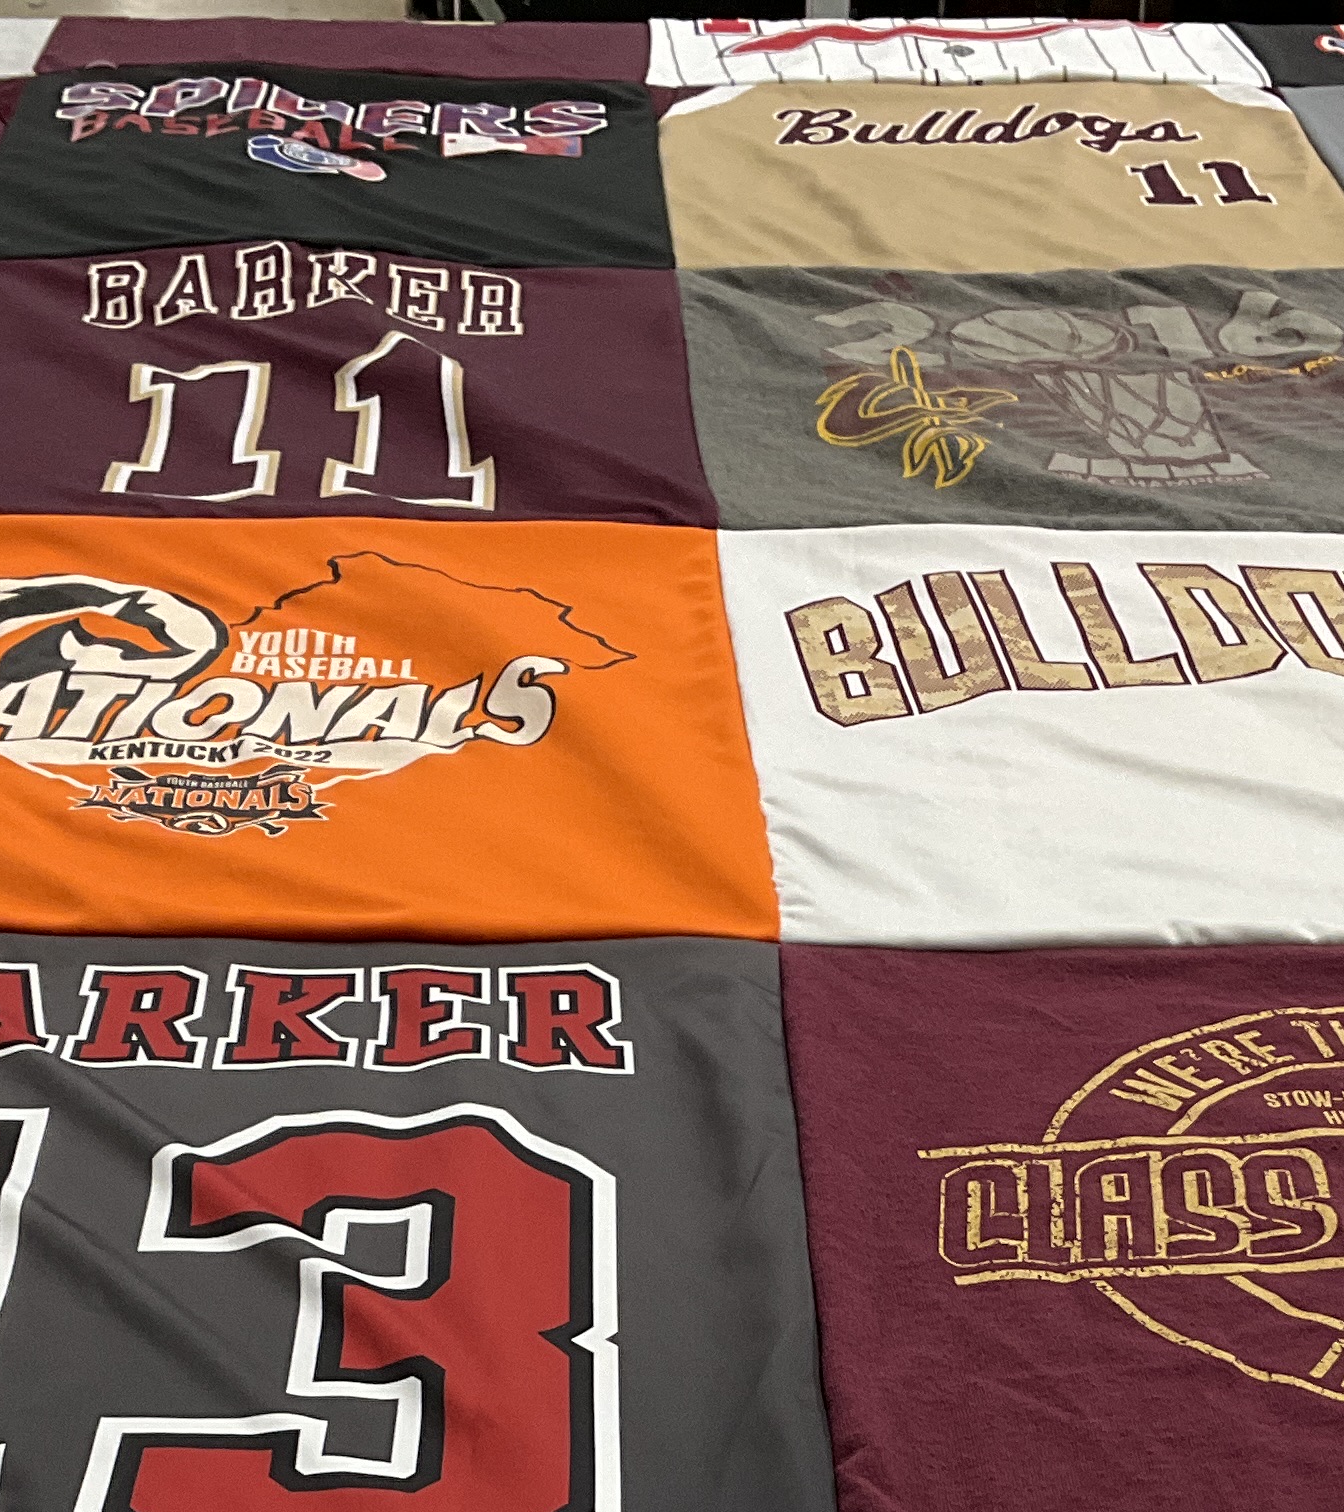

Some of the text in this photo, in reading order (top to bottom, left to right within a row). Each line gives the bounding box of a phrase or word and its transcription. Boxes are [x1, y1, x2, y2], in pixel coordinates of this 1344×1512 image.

[775, 104, 1202, 153] Bulldogs
[1126, 160, 1278, 207] 11
[82, 241, 524, 336] BARKER
[100, 331, 496, 512] 11
[236, 627, 359, 656] YOUTH
[231, 652, 419, 681] BASEBALL
[88, 739, 333, 764] KENTUCKY 2022
[93, 782, 313, 812] NATIONALS
[1108, 1030, 1298, 1112] WE'RE
[938, 1147, 1337, 1269] CLASS
